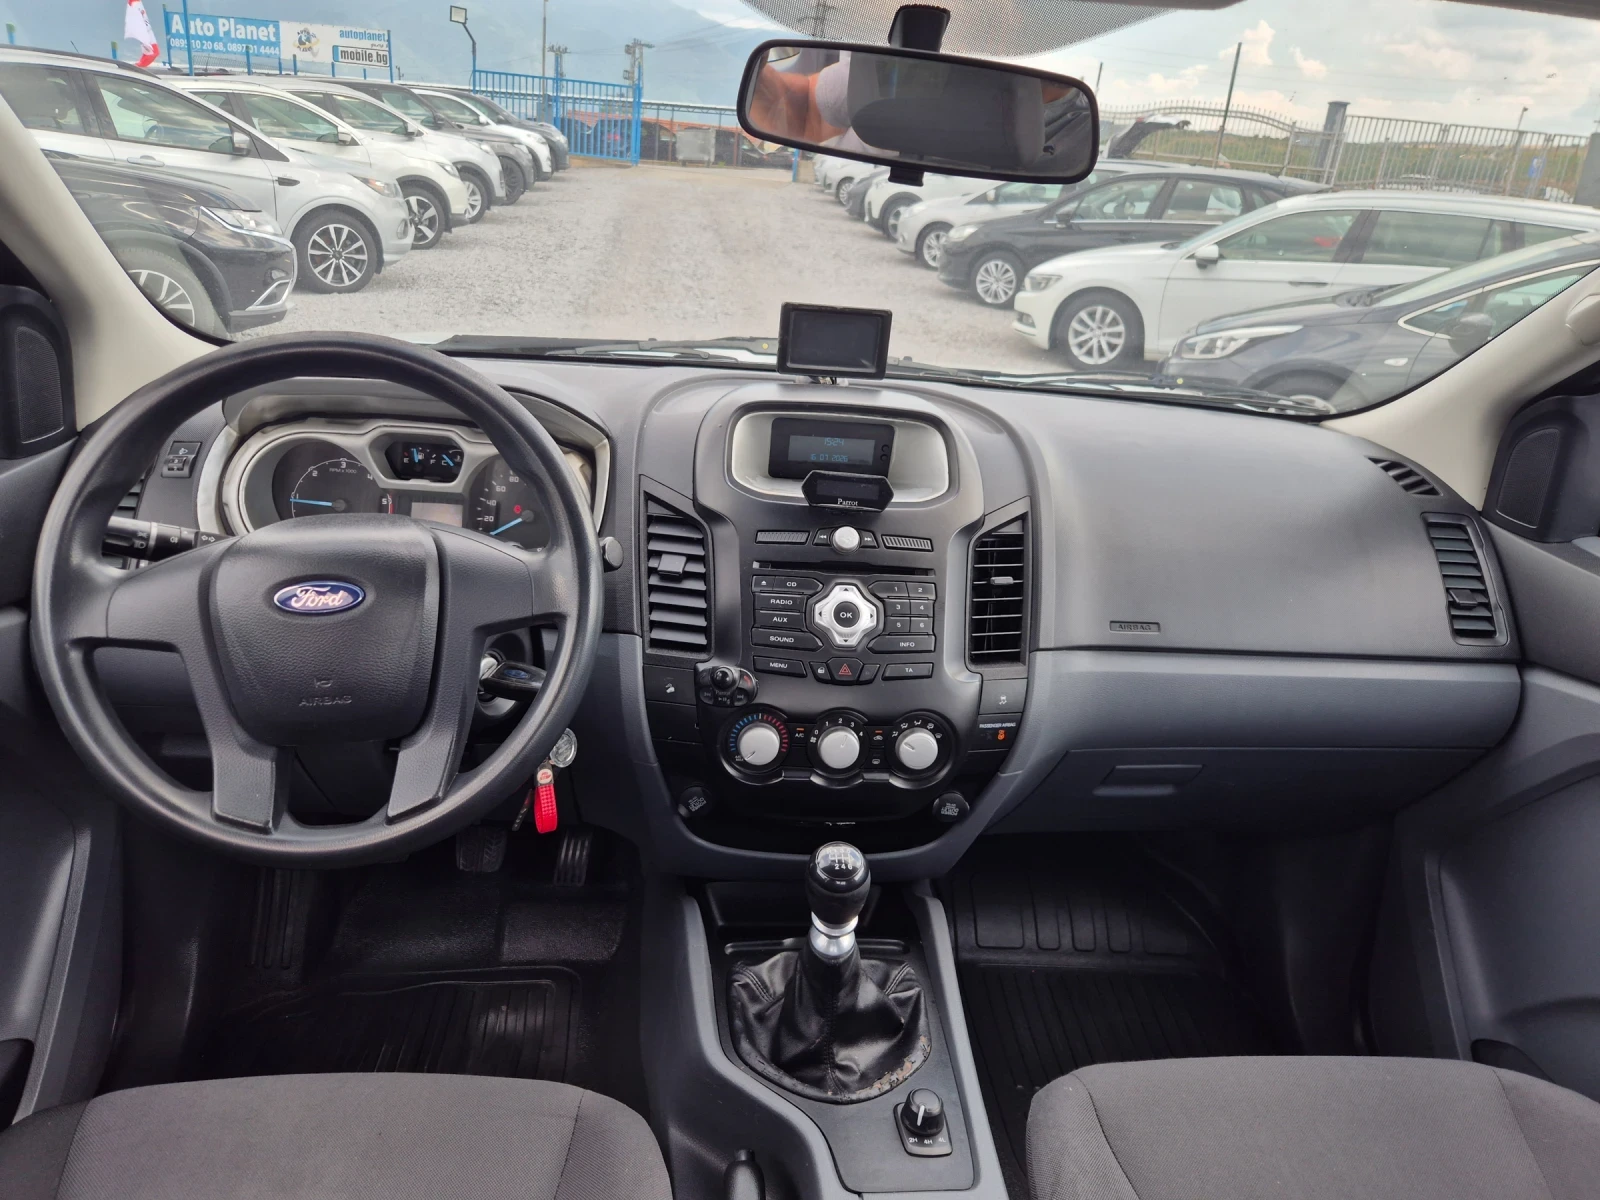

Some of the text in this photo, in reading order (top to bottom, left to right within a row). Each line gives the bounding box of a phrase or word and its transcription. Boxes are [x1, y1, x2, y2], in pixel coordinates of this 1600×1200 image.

[171, 14, 276, 41] Auto Planet
[191, 39, 201, 49] 10
[202, 40, 212, 50] 20
[227, 43, 246, 52] 0897
[260, 45, 279, 55] 4444
[340, 49, 388, 65] mobile.bg
[340, 461, 347, 469] 3
[367, 473, 374, 481] 4
[509, 475, 520, 483] 80
[495, 485, 506, 493] 60
[837, 498, 859, 507] Parrot
[291, 586, 343, 608] Ford
[839, 611, 853, 619] OK
[769, 635, 795, 643] SOUND
[299, 695, 352, 707] AIRBAG
